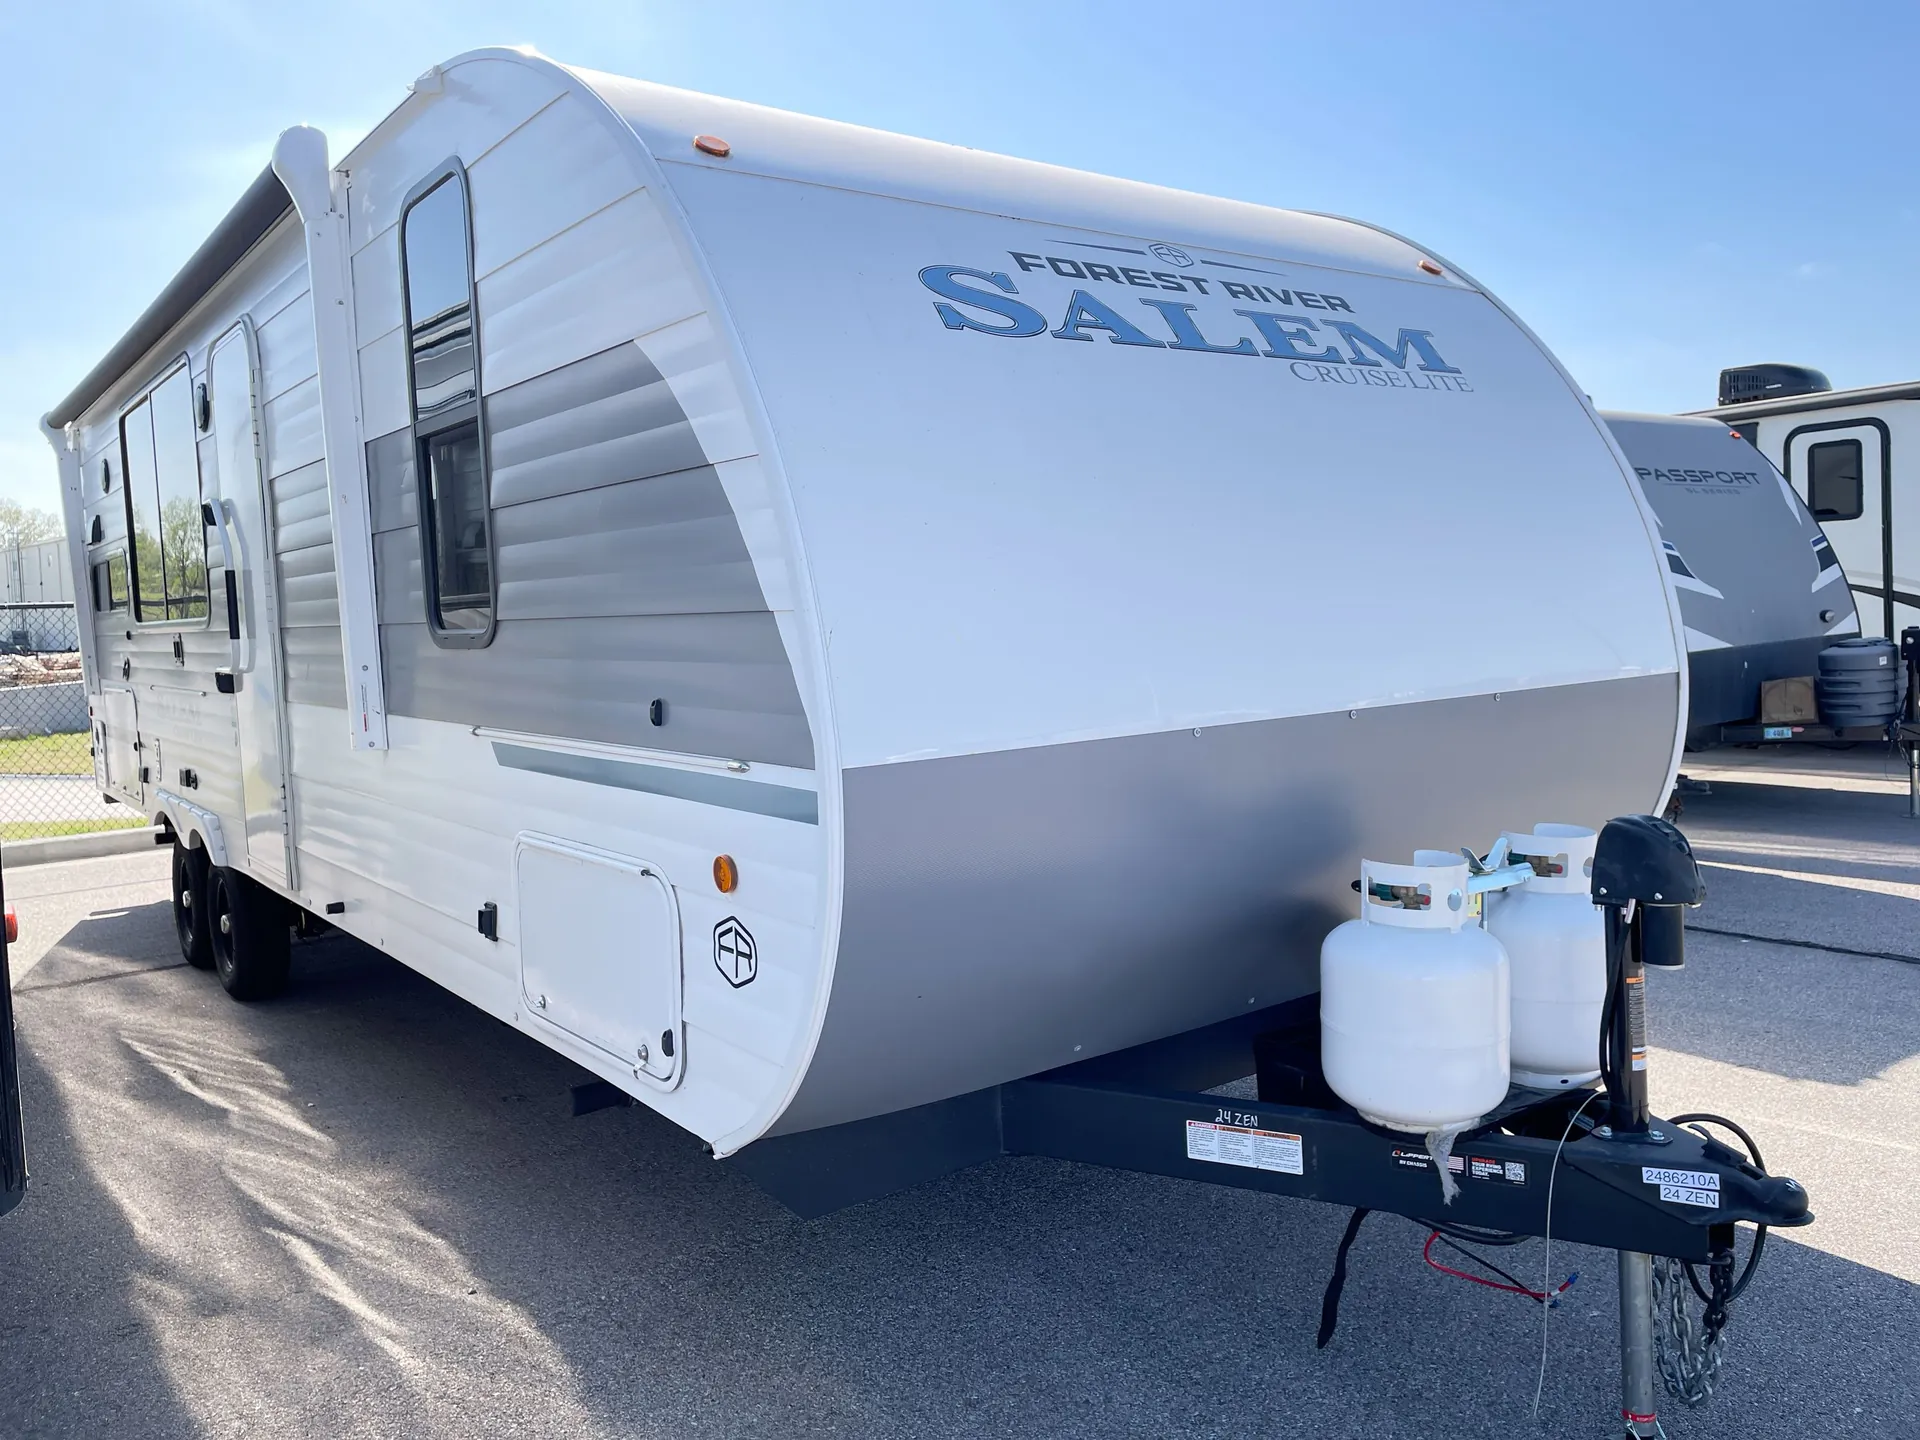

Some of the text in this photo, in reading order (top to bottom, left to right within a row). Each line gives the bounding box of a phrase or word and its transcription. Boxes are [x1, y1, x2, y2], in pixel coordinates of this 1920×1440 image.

[1007, 250, 1357, 313] FOREST RIVER
[918, 265, 1463, 374] SALEM
[1289, 361, 1474, 392] CRUISELITE
[1634, 467, 1761, 485] PASSPORT
[1702, 487, 1741, 495] SERIES
[1216, 1108, 1258, 1127] 24 ZEN
[1645, 1169, 1718, 1187] 2486210A
[1663, 1187, 1716, 1206] 24 ZEN
